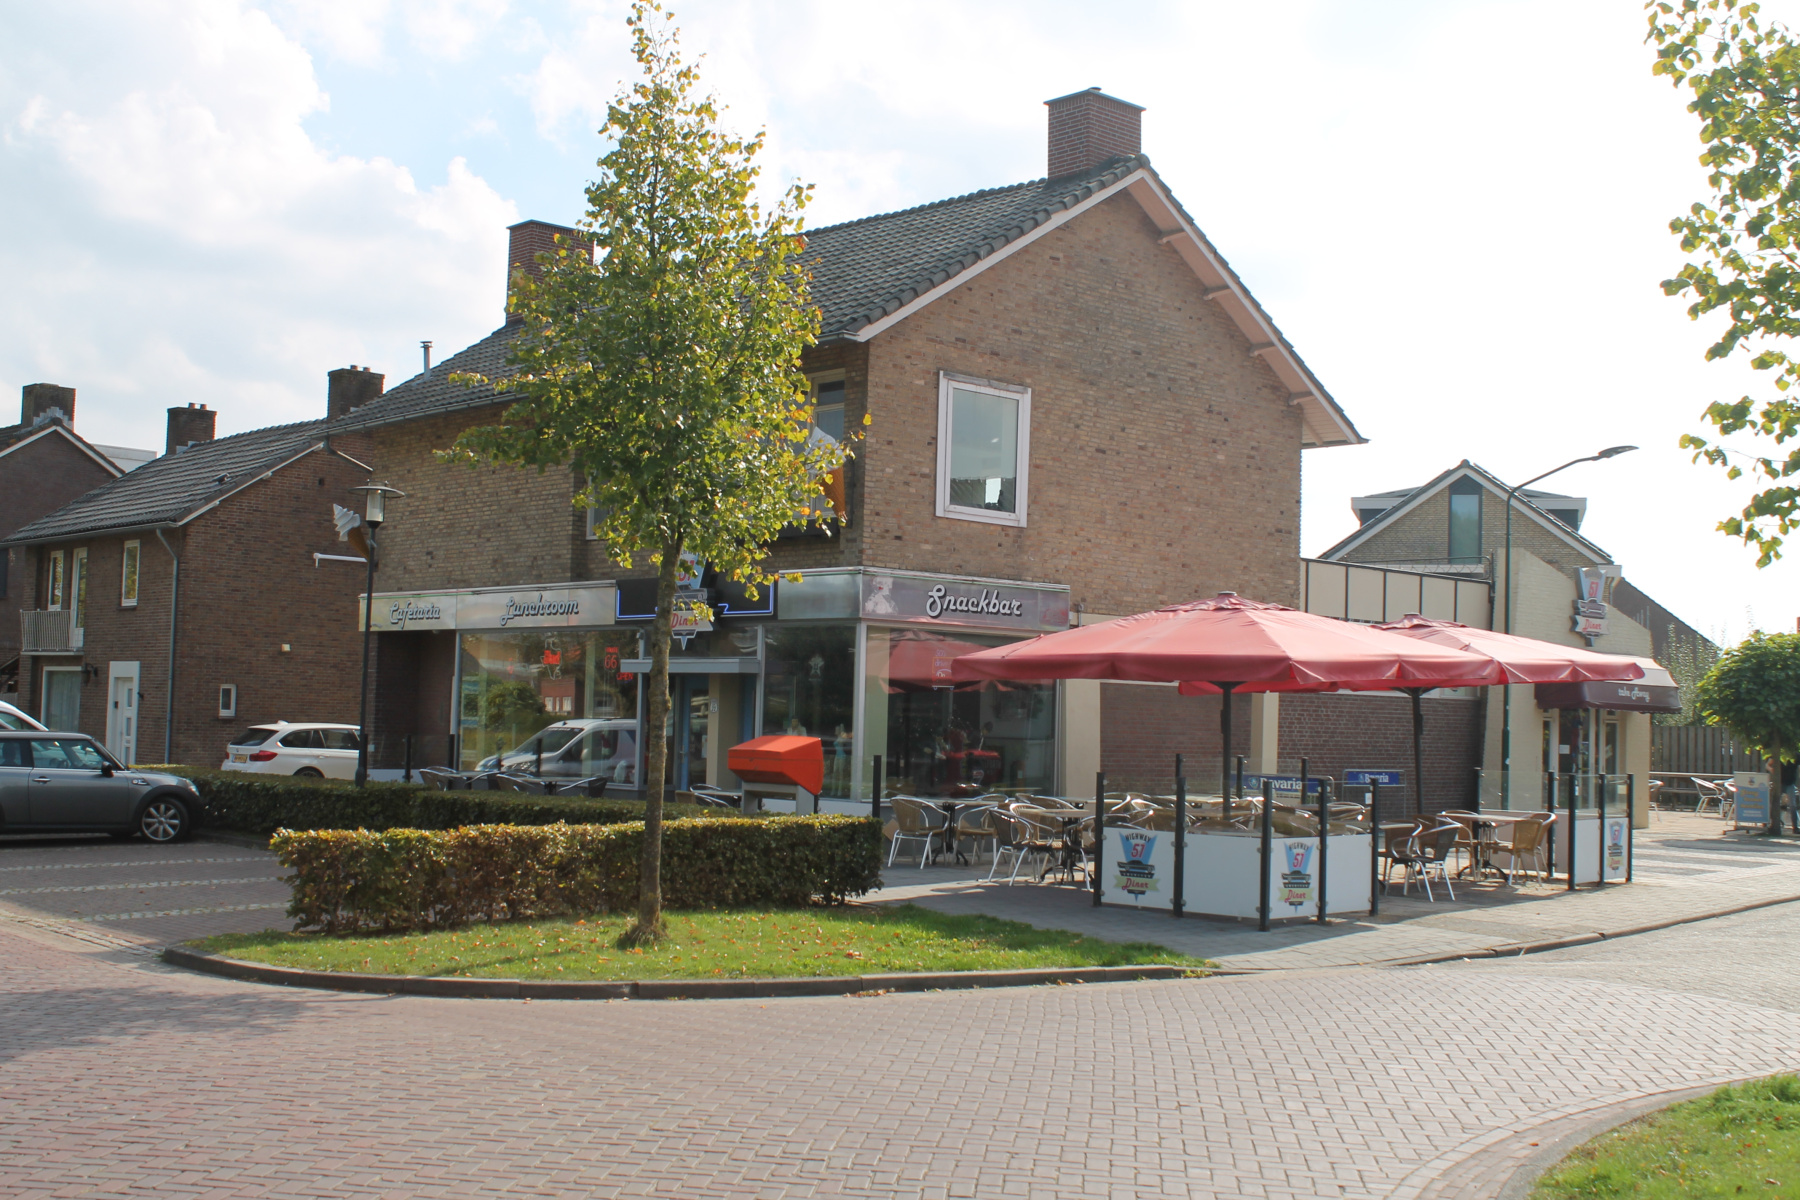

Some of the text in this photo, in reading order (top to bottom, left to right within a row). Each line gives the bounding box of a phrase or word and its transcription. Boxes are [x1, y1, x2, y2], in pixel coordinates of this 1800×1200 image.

[926, 584, 1022, 618] Snackbar
[390, 600, 441, 630] Cafetaria
[501, 592, 579, 626] Lunchroom
[605, 654, 618, 669] 66
[1125, 832, 1151, 843] HIGHWAY
[1131, 843, 1146, 859] 57
[1289, 842, 1309, 852] HIGHWAY
[1293, 853, 1305, 868] 57
[1122, 877, 1149, 891] Diner
[1284, 889, 1306, 904] Diner
